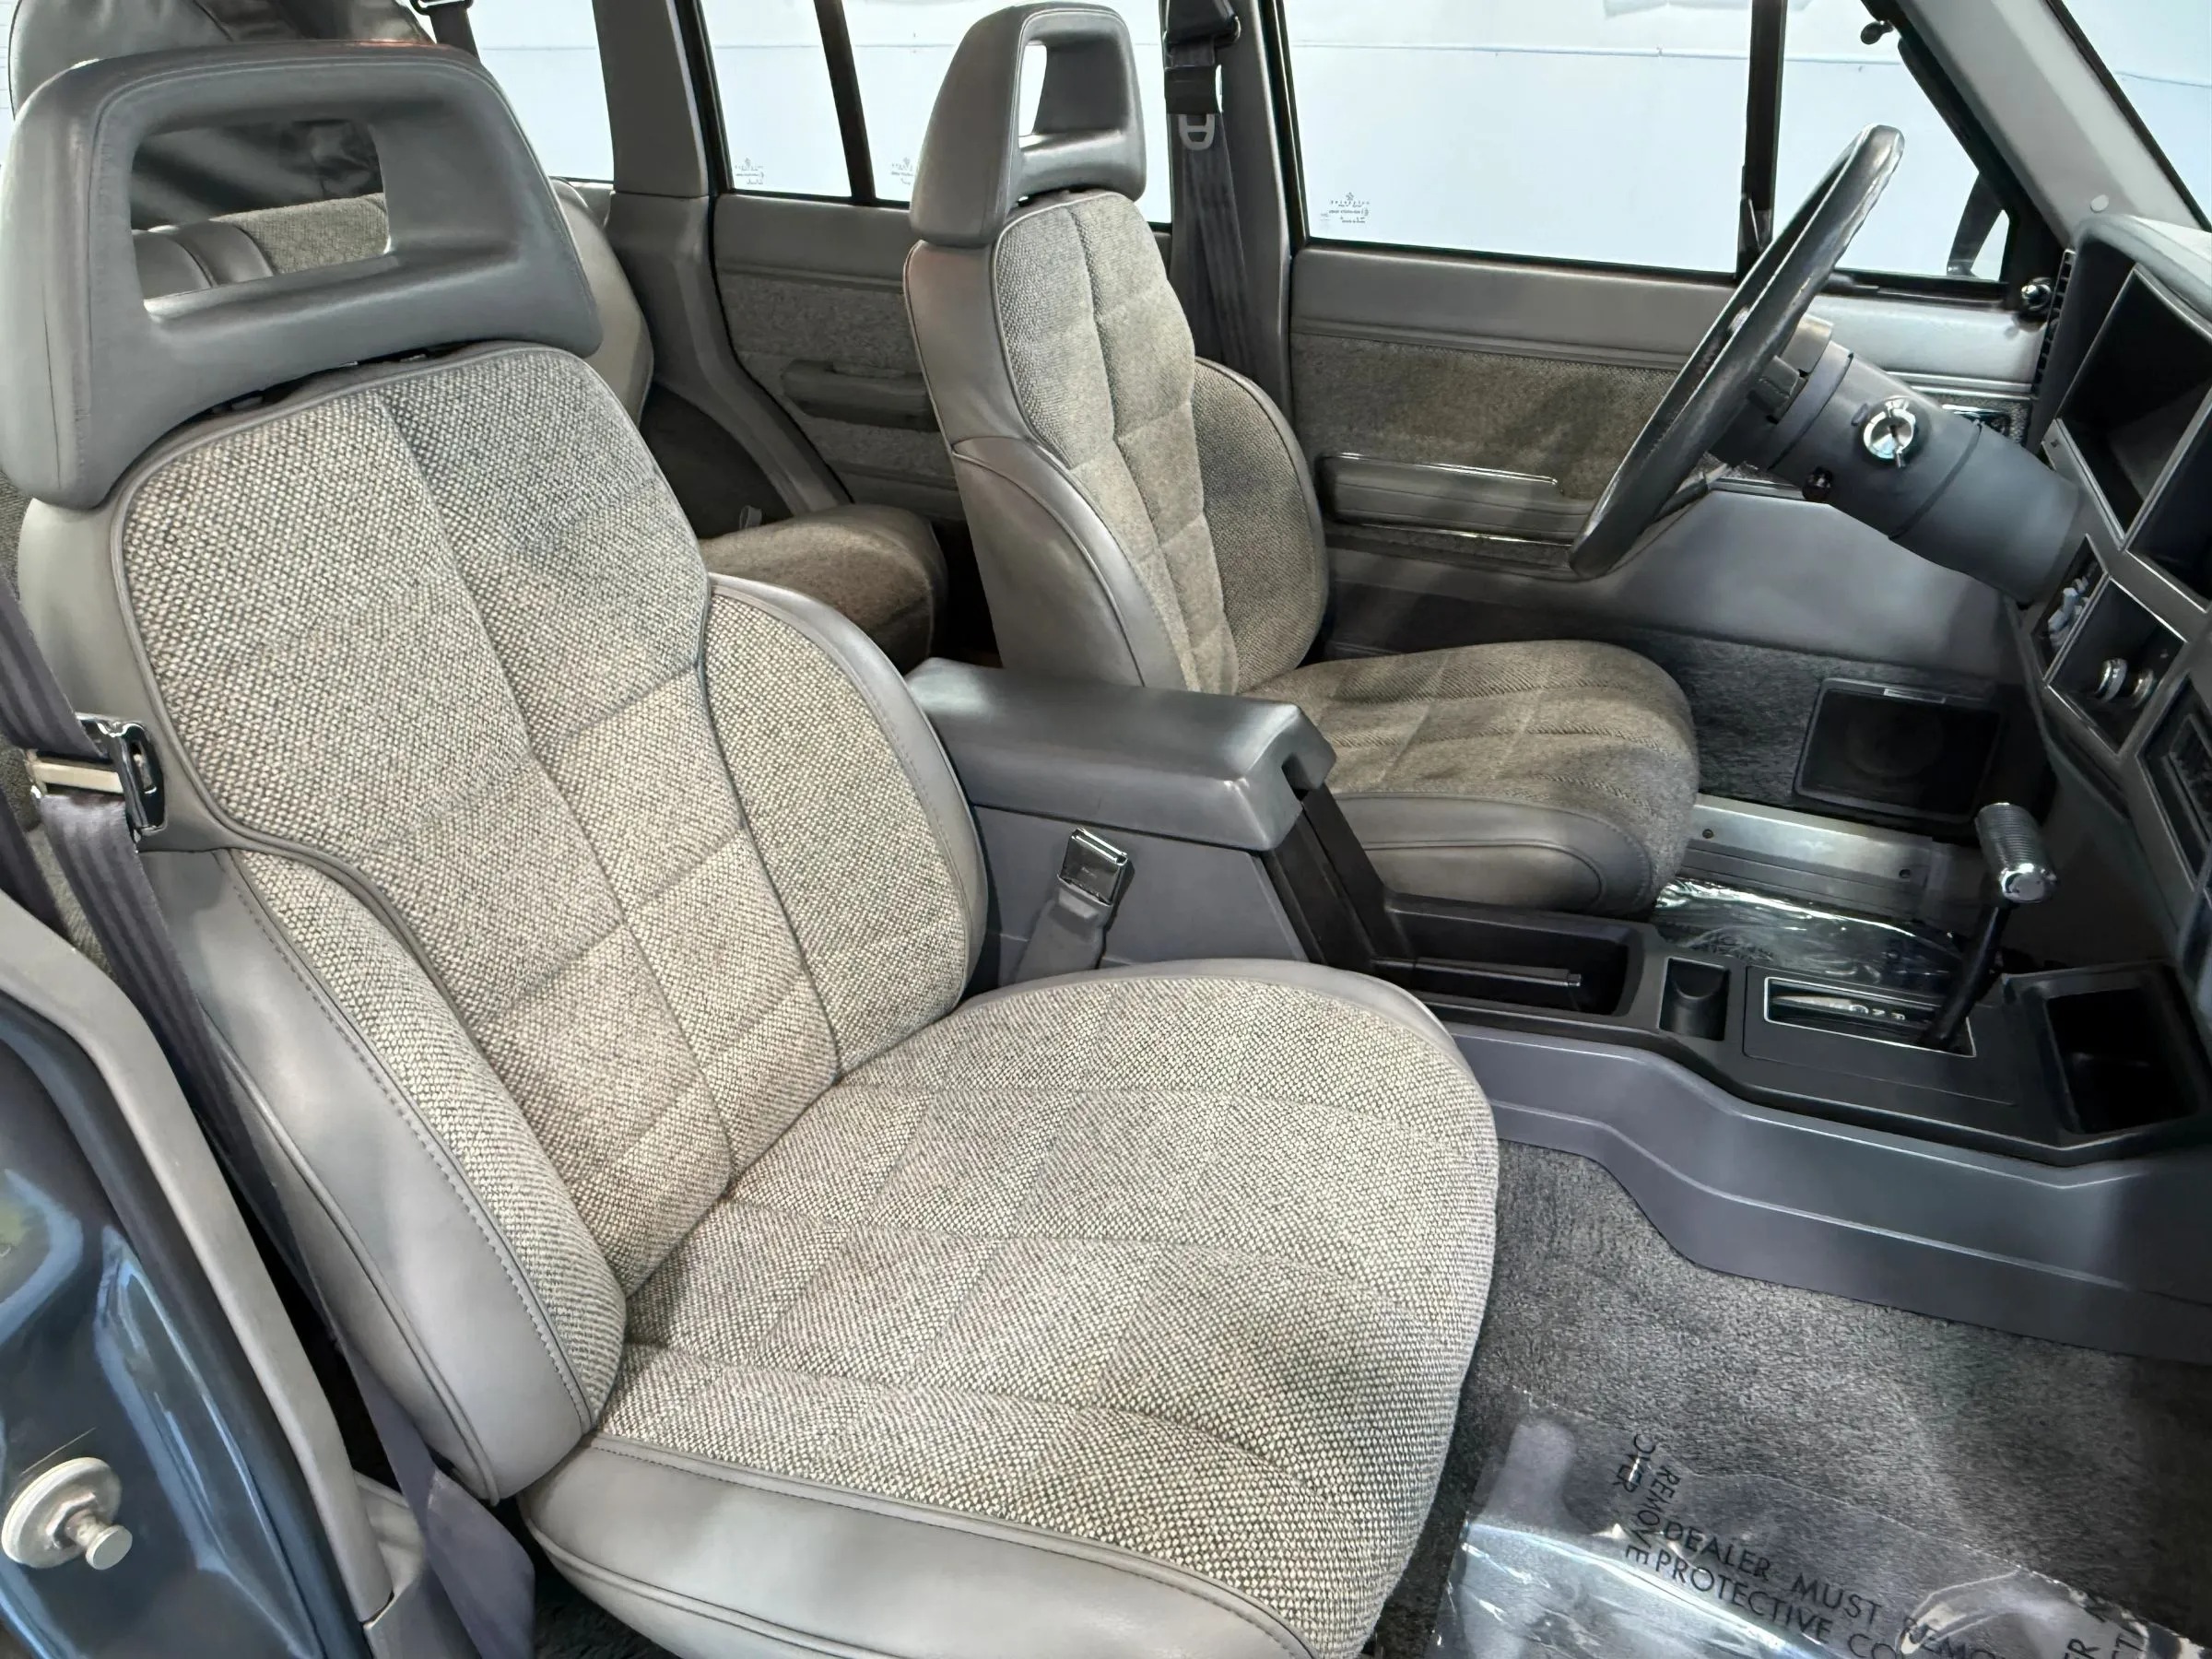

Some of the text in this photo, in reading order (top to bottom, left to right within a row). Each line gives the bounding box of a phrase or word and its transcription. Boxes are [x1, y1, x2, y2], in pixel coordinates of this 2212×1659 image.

[1625, 1465, 1681, 1565] REMOVE
[1655, 1550, 1833, 1644] PROTECTIVE
[1664, 1521, 1771, 1582] DEALER
[1790, 1572, 1882, 1625] MUST
